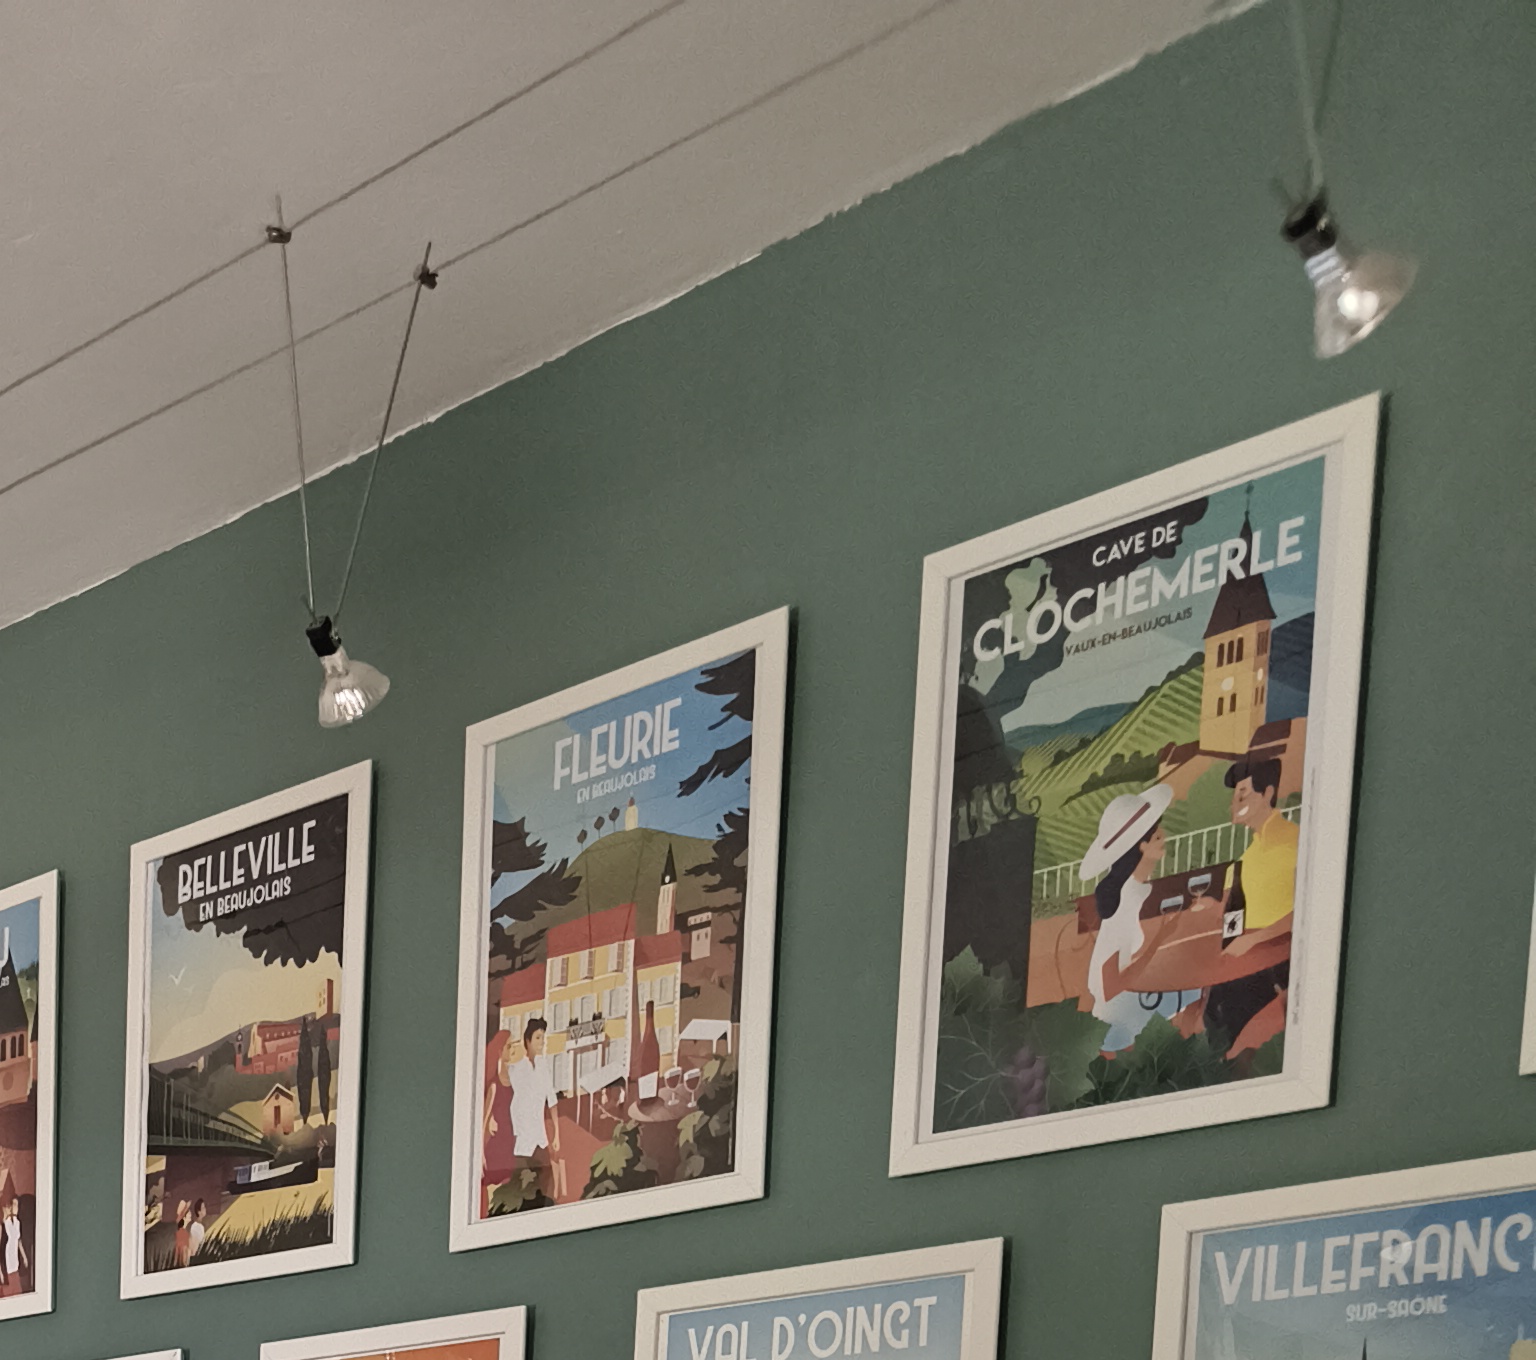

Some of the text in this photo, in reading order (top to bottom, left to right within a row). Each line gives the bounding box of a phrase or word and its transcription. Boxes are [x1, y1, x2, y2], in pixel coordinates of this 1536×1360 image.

[1092, 520, 1178, 567] CAVE DE
[972, 515, 1306, 662] CLOCHEMERLE
[1064, 606, 1193, 657] VAUX-EN-BEAUJOLAIS
[553, 697, 683, 791] FLEURIE
[576, 764, 657, 804] EN BEAUJOLAIS
[177, 820, 317, 904] BELLEVILLE
[199, 875, 292, 923] EN BEAUJOLAIS
[1214, 1213, 1536, 1305] VILLEFRANC
